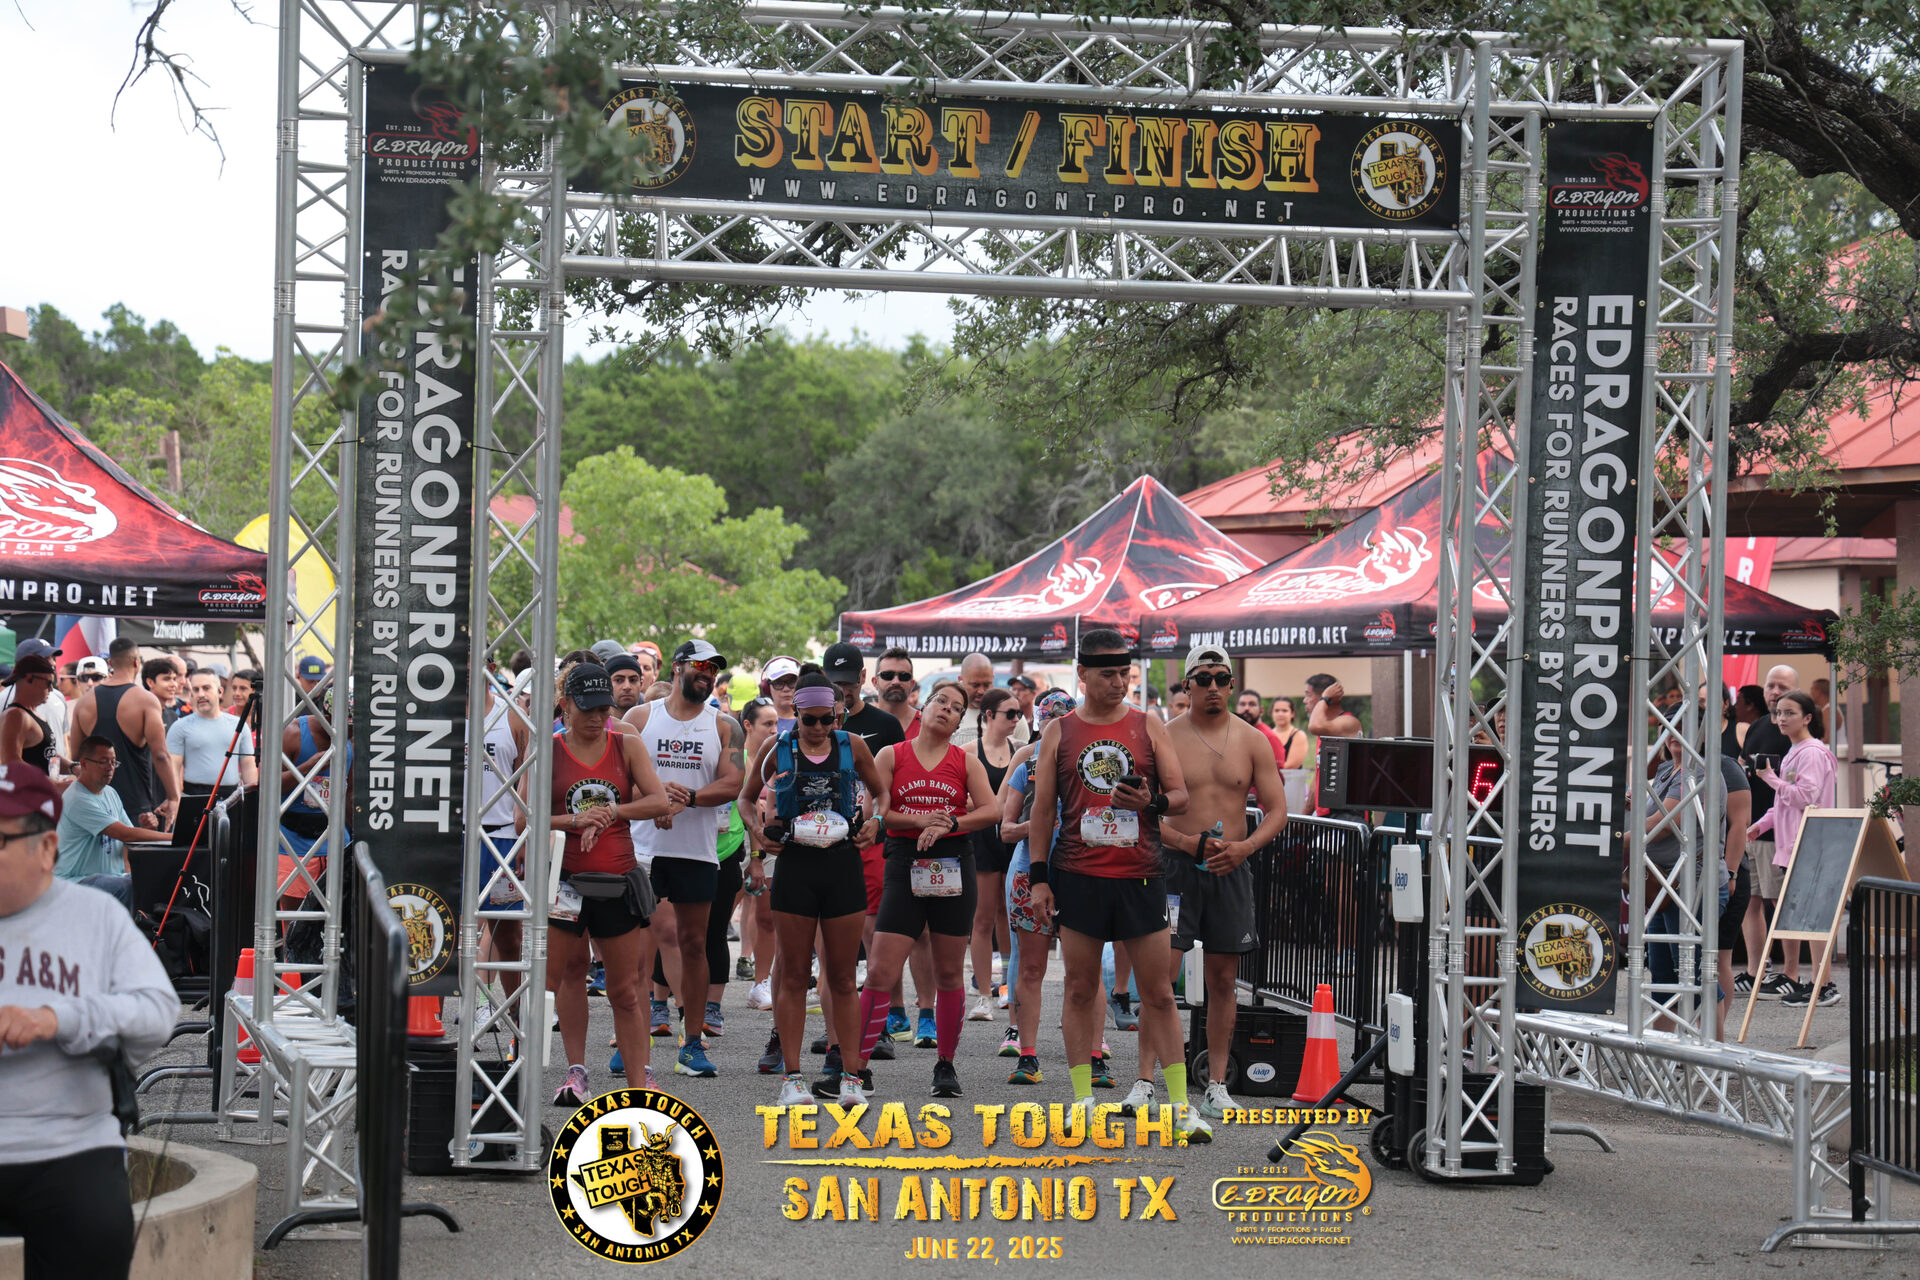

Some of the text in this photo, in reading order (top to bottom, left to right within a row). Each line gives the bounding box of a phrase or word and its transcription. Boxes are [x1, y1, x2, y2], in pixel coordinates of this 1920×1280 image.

[607, 89, 687, 119] TEXAS TGH
[734, 97, 1321, 193] START / FINISH
[1362, 123, 1438, 151] TEXAS TOUGH
[378, 158, 465, 169] PRODUCTIONS
[1371, 170, 1407, 185] TOUGH
[750, 178, 1294, 220] WWW.EDRAGONTPRO.NET
[1367, 199, 1383, 213] SAN
[1418, 201, 1429, 211] TX
[1558, 209, 1636, 217] PRODUCTIONS
[376, 370, 405, 442] FOR
[372, 452, 403, 609] RUNNERS
[1529, 296, 1578, 852] RACES FOR RUNNERS BY RUNNERS
[1565, 295, 1634, 857] EDRAGONPRO.NET
[372, 620, 399, 663] BY
[1189, 626, 1348, 648] WWW.EDRAGONPRO.NET
[583, 678, 608, 688] WTF!
[368, 674, 398, 831] RUNNERS
[657, 739, 704, 754] HOPE
[656, 760, 701, 770] WARRIORS
[898, 780, 957, 797] ALAMO RANCH
[904, 796, 950, 804] RUNNERS
[815, 824, 830, 835] 77
[1102, 823, 1118, 835] 72
[930, 874, 944, 885] 83
[411, 886, 447, 913] TOUGH
[1526, 905, 1564, 927] TEXAS
[1571, 906, 1607, 934] TOUGH
[1536, 951, 1573, 965] TOUGH
[16, 946, 80, 997] A&M
[1531, 979, 1548, 992] SAN
[1584, 983, 1596, 993] TX
